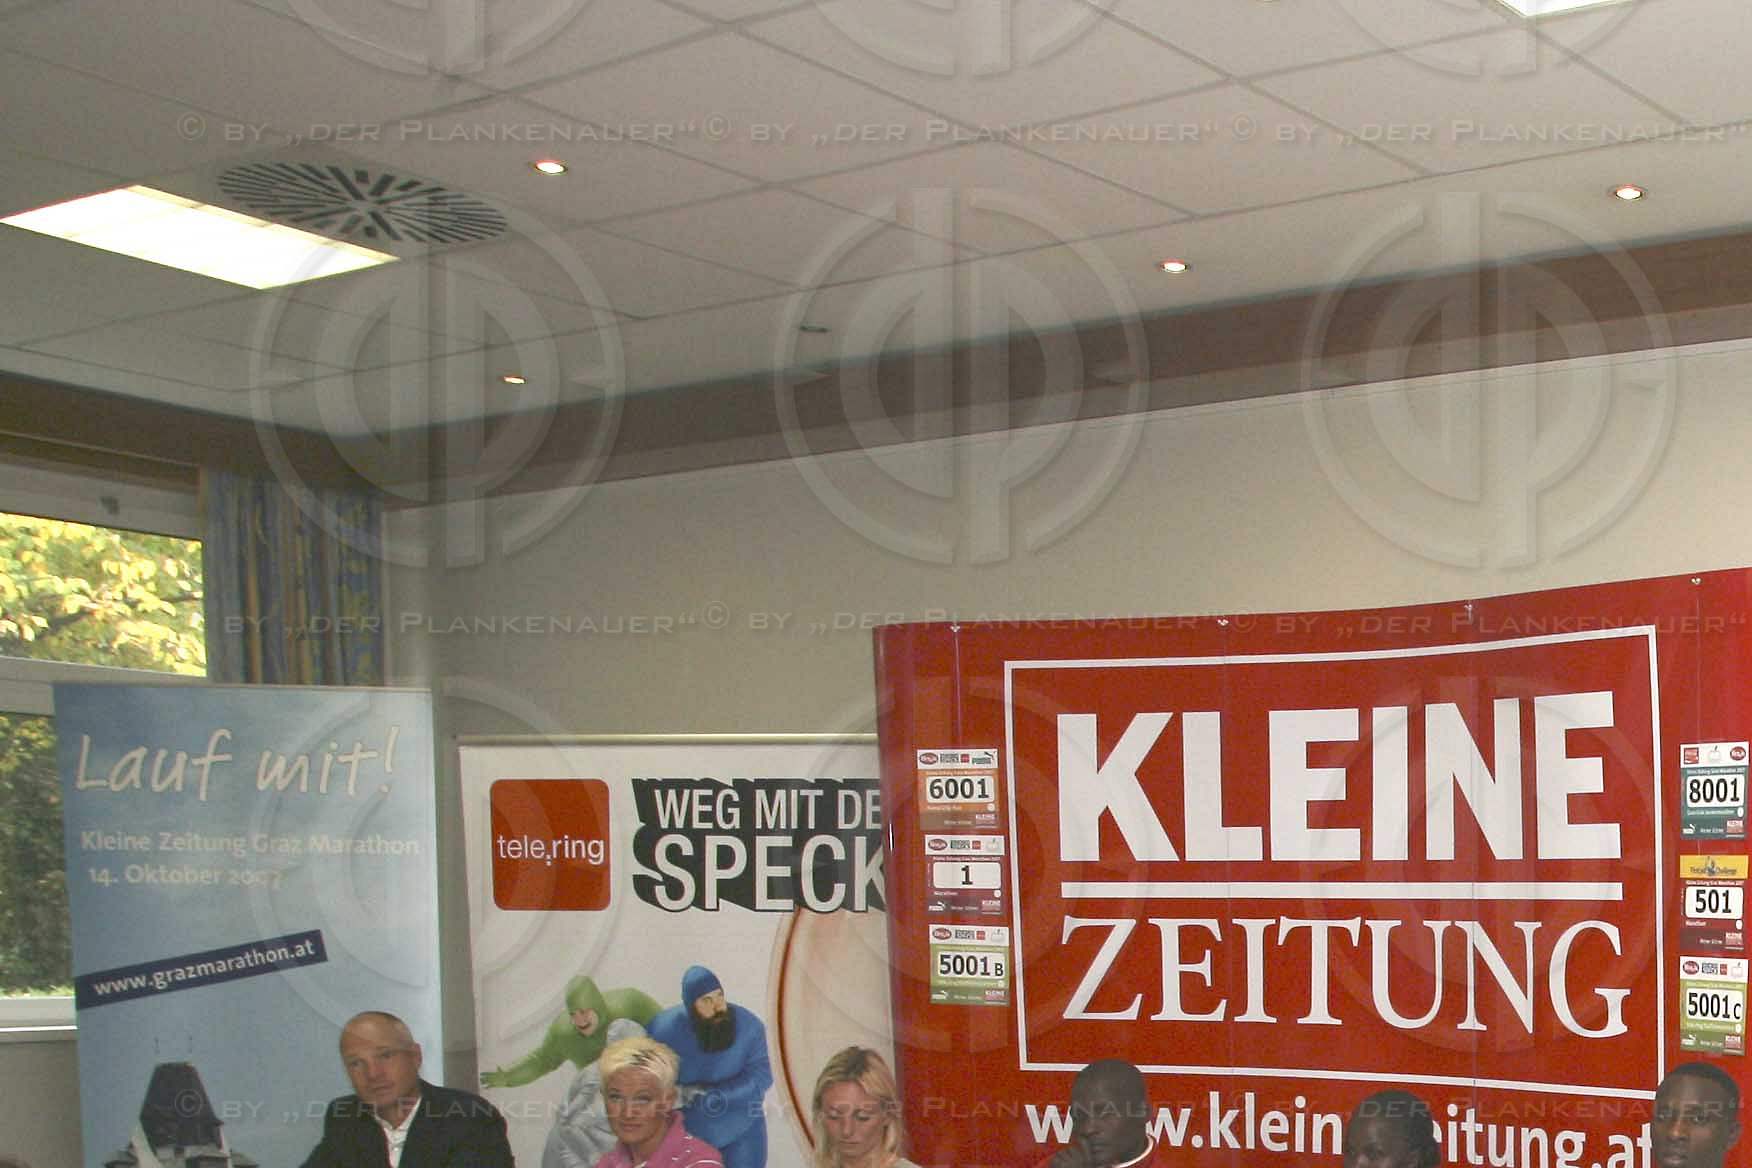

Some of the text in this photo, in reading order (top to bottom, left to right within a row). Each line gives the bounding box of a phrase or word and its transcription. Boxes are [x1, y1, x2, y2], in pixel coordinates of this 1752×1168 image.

[74, 725, 400, 801] Lauf mit!
[1055, 690, 1623, 862] KLEINE
[929, 778, 989, 800] 6001
[1689, 778, 1740, 803] 8001
[654, 788, 881, 829] WEG MIT DE
[81, 831, 421, 859] Kleine Zeitung Graz Marathon
[124, 863, 221, 885] Oktober
[961, 865, 973, 885] 1
[1695, 889, 1731, 913] 501
[94, 939, 315, 995] www.grazmarathon.at
[1060, 911, 1630, 1040] ZEITUNG
